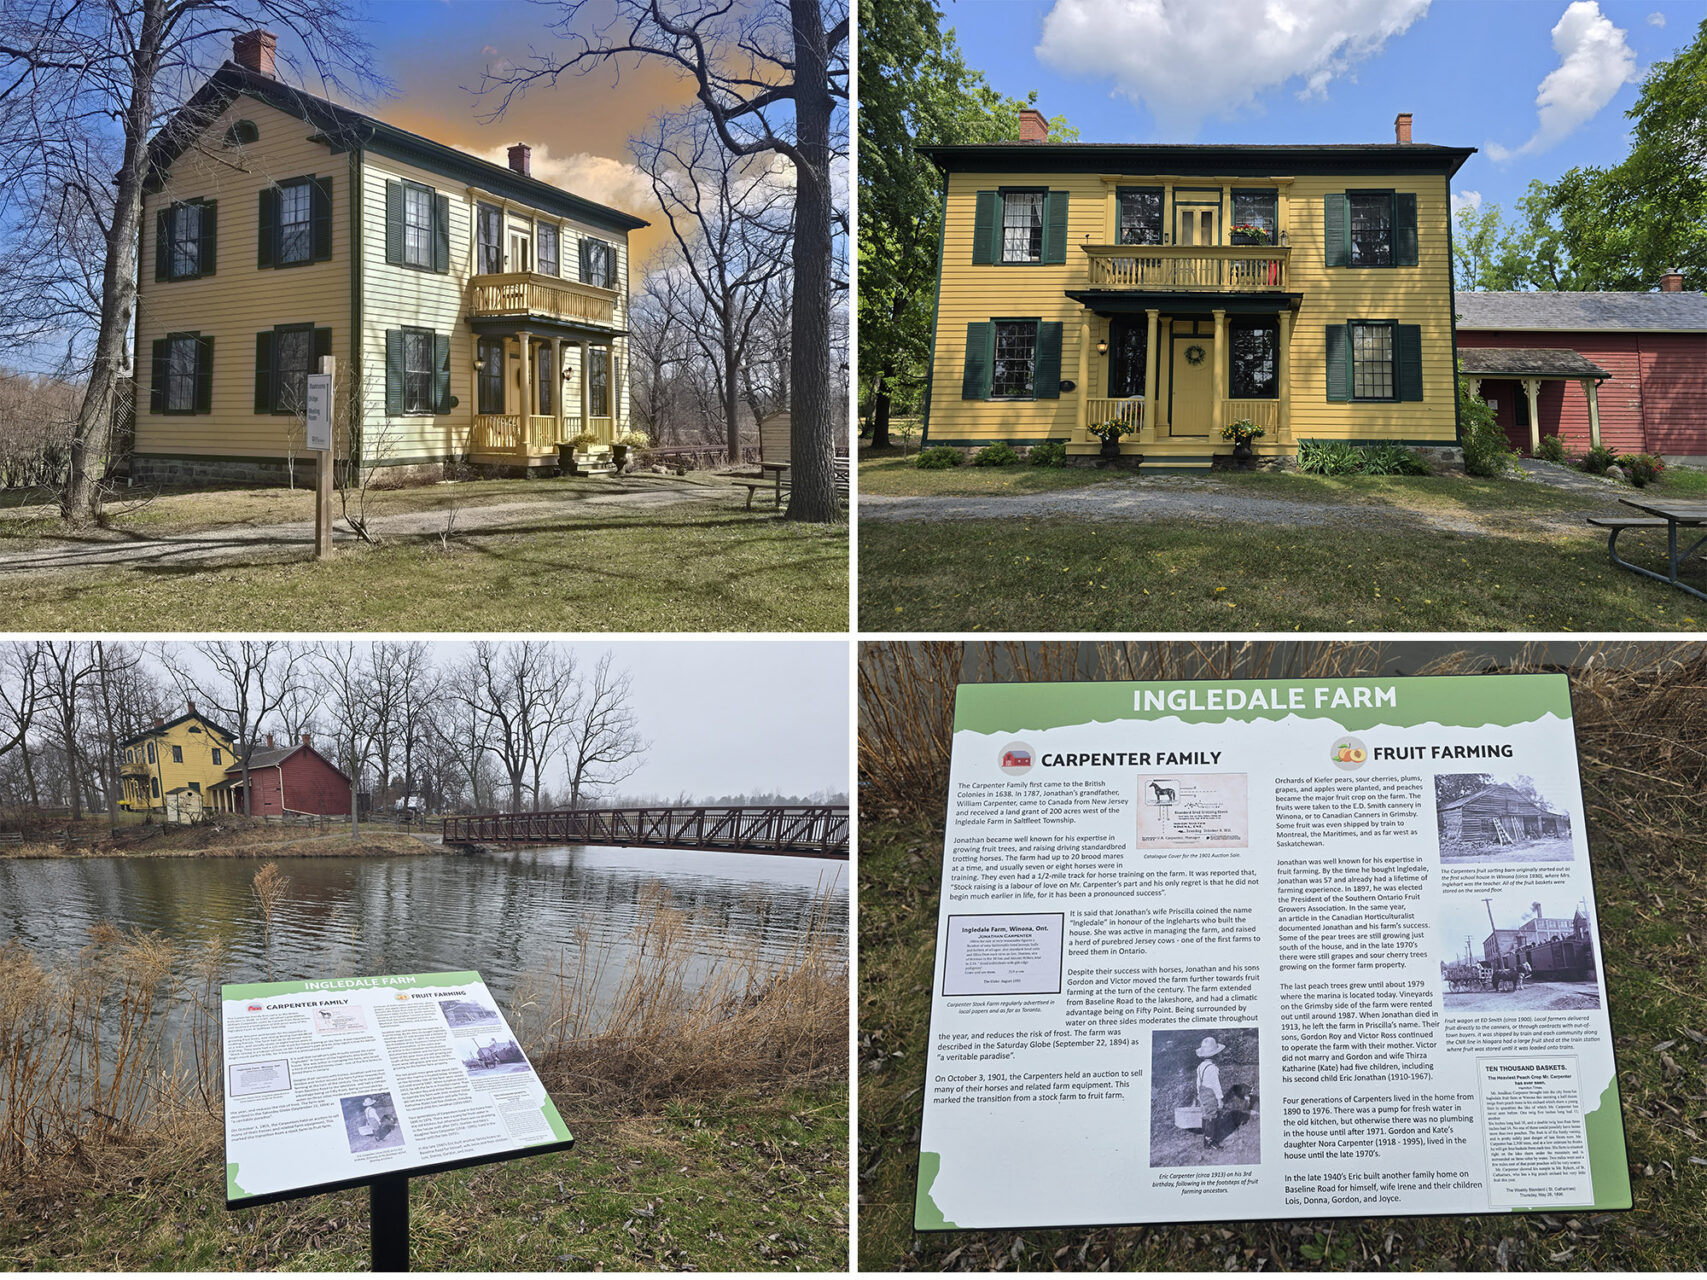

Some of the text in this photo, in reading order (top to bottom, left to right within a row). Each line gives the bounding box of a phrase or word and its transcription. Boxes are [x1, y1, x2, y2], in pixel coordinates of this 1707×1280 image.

[1134, 686, 1396, 711] INGLEDALE FARM
[1042, 752, 1221, 767] CARPENTER FAMILY
[1374, 745, 1513, 760] FRUIT FARMING
[305, 976, 416, 989] INGLEDALE FARM
